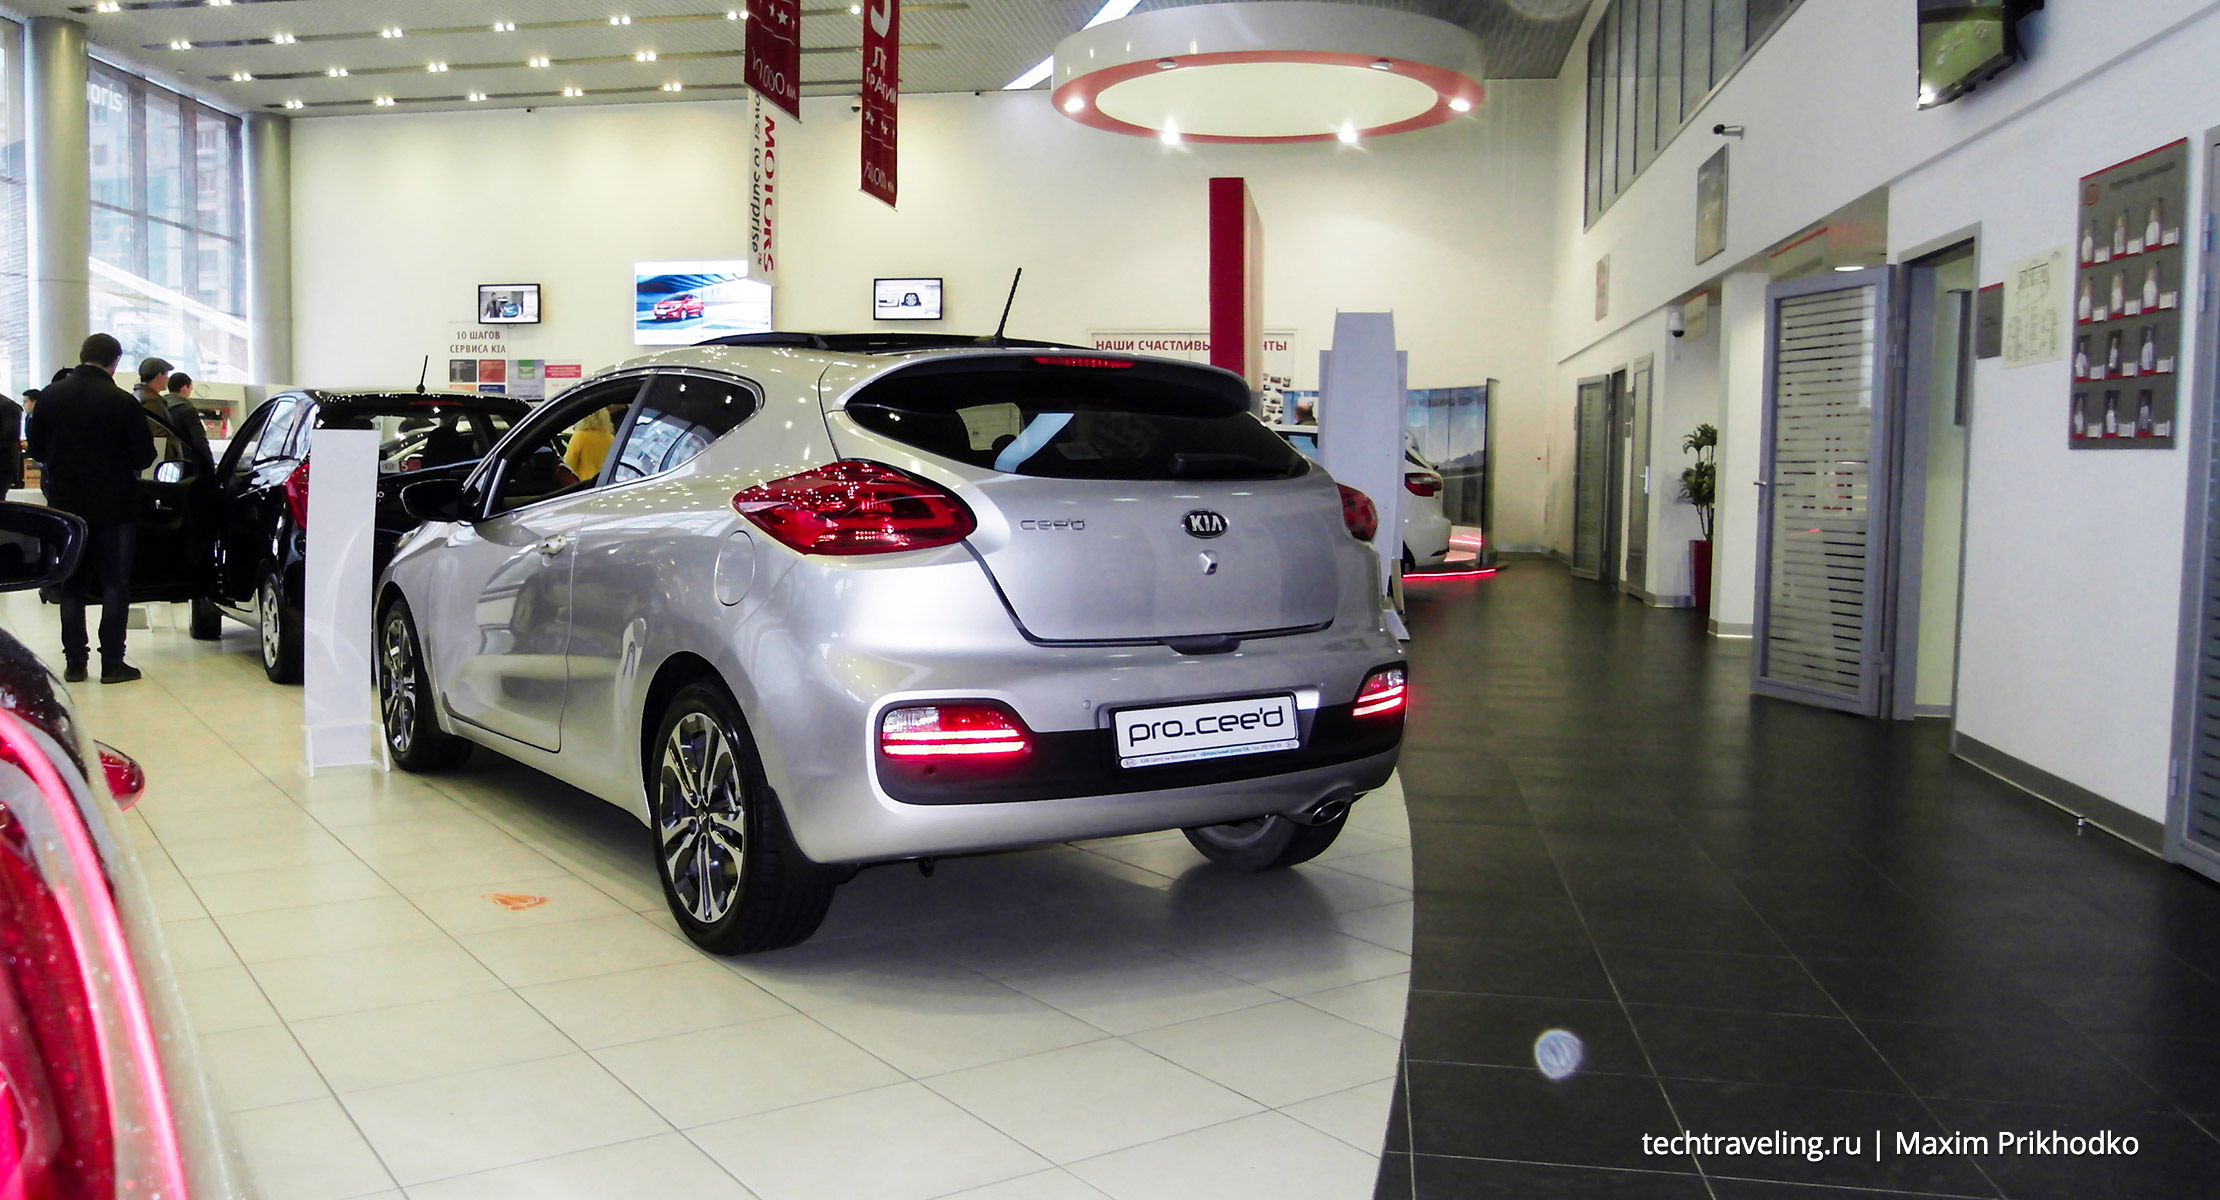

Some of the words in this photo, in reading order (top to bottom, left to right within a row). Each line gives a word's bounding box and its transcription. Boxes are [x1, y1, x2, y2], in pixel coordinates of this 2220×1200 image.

[87, 81, 123, 113] oris
[753, 94, 761, 141] ower
[763, 115, 776, 273] MOTORS
[456, 331, 467, 340] 10
[469, 330, 501, 340] ШАГОВ
[449, 344, 489, 354] СЕРВИСА
[1096, 340, 1135, 351] НАШИ
[1138, 340, 1211, 351] СЧАСТЛИВЫ
[1189, 514, 1223, 533] KIA
